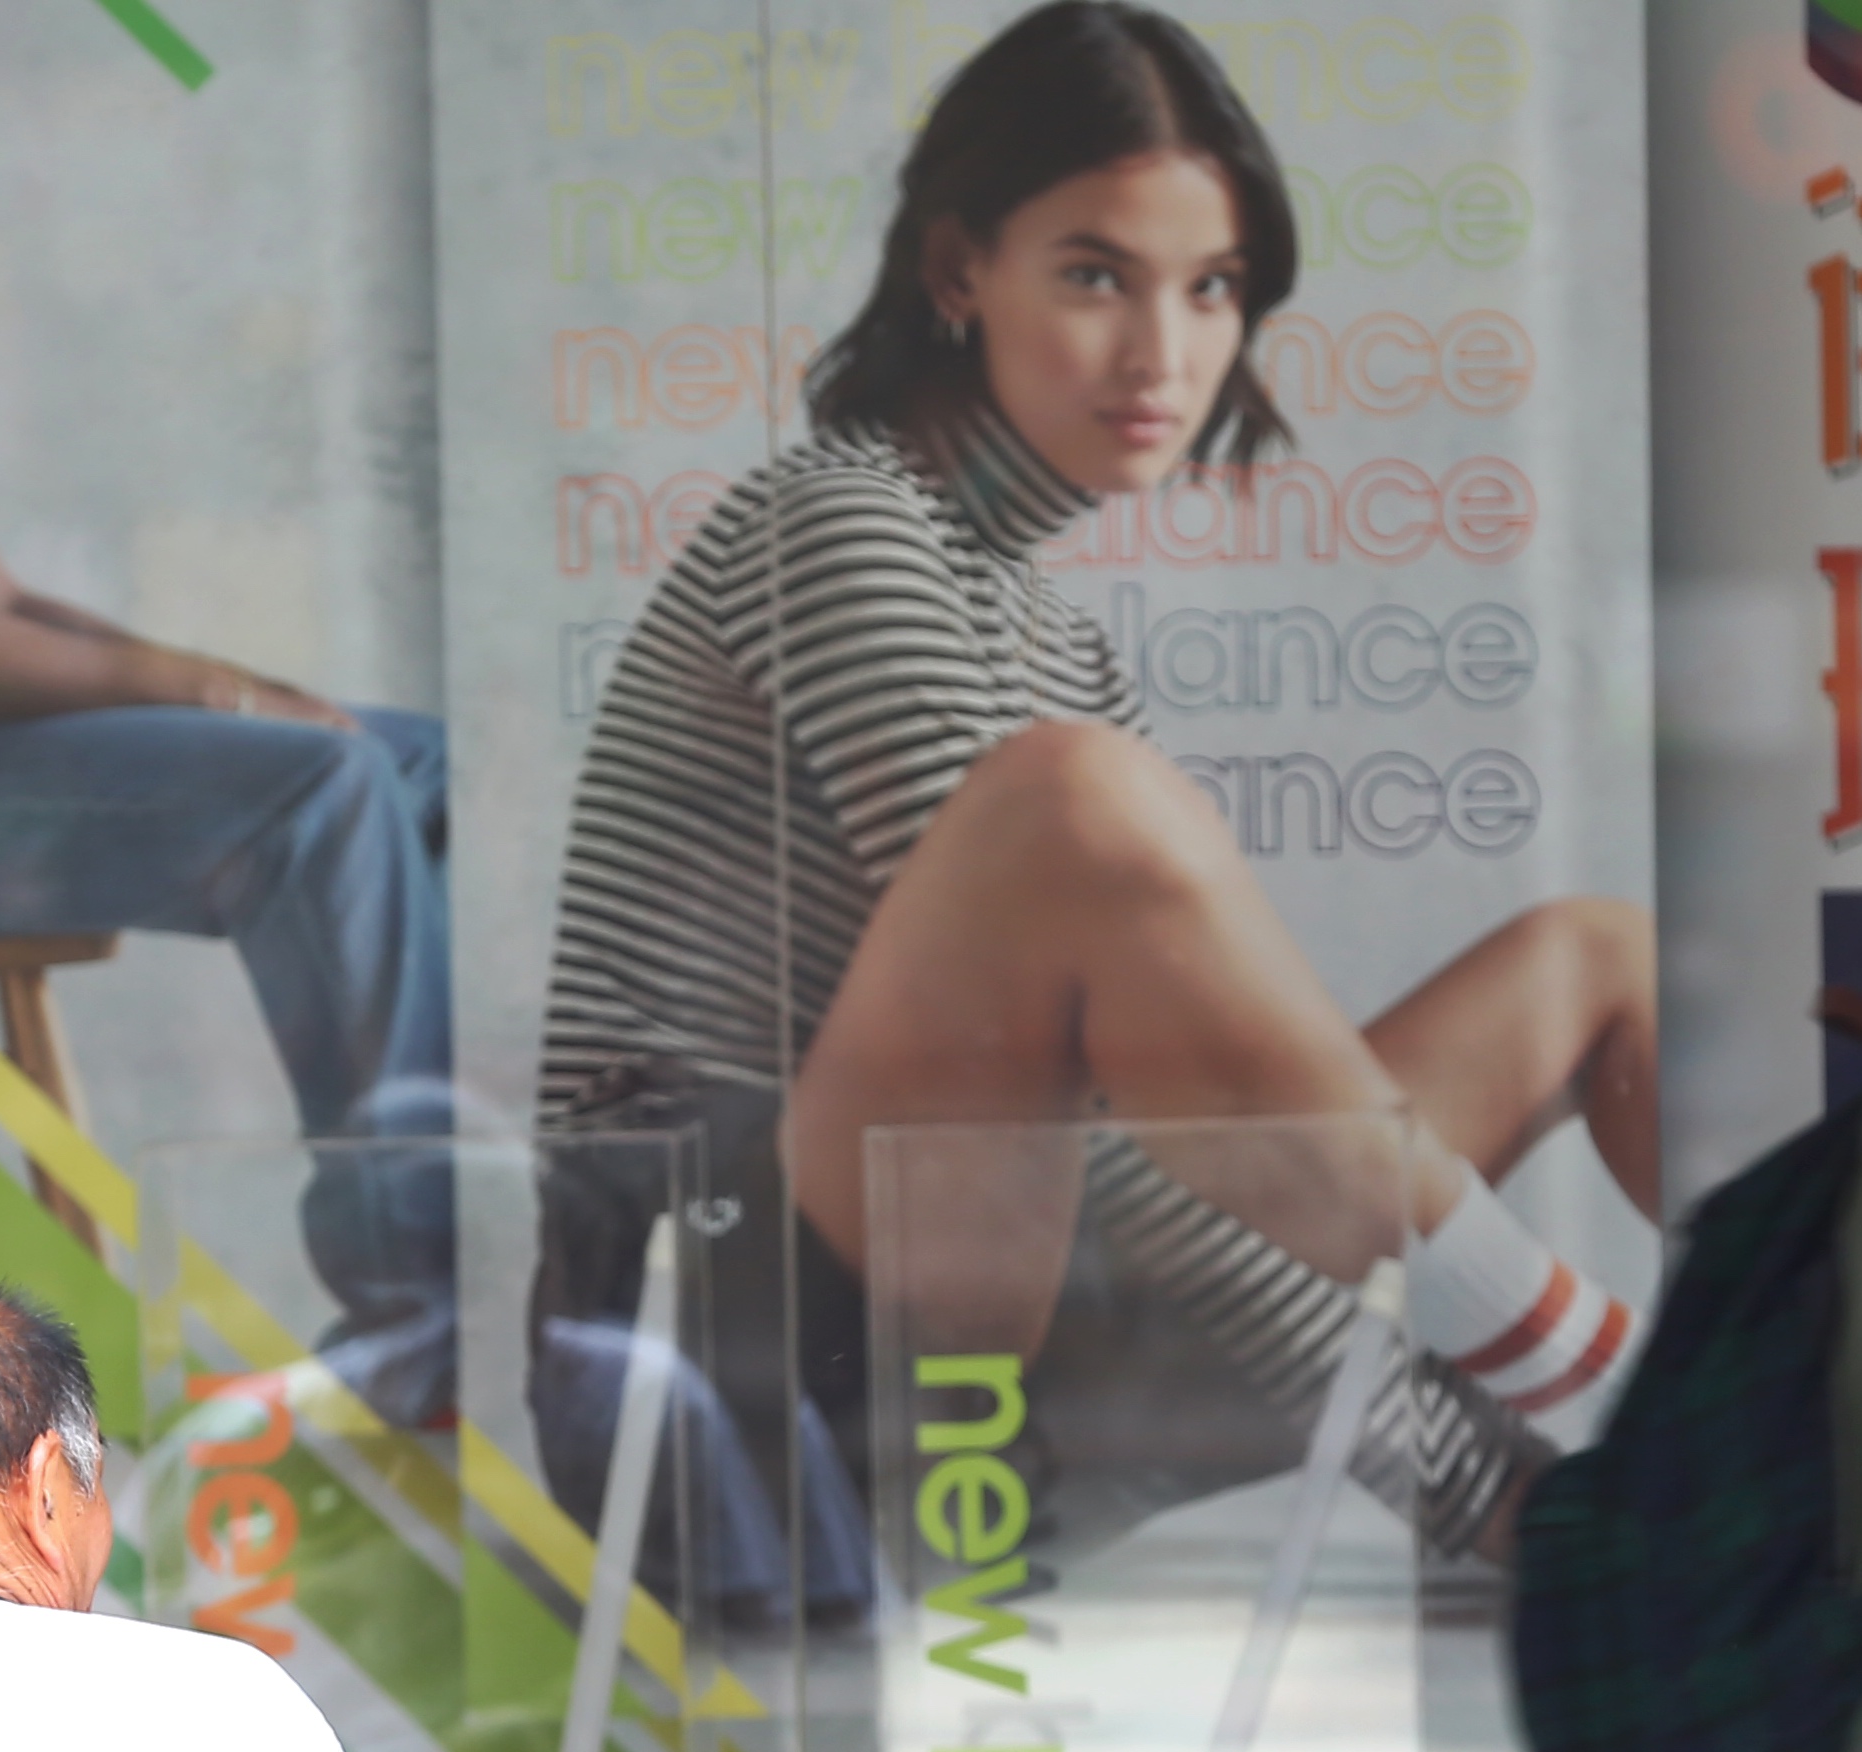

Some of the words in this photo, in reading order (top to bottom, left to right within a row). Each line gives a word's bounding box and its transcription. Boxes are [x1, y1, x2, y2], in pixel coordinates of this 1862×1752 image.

[544, 24, 860, 138] new
[890, 0, 1535, 132] bnce
[549, 174, 864, 285] new
[555, 470, 736, 580] ne
[1111, 580, 1540, 715] lance
[914, 1353, 1030, 1696] new
